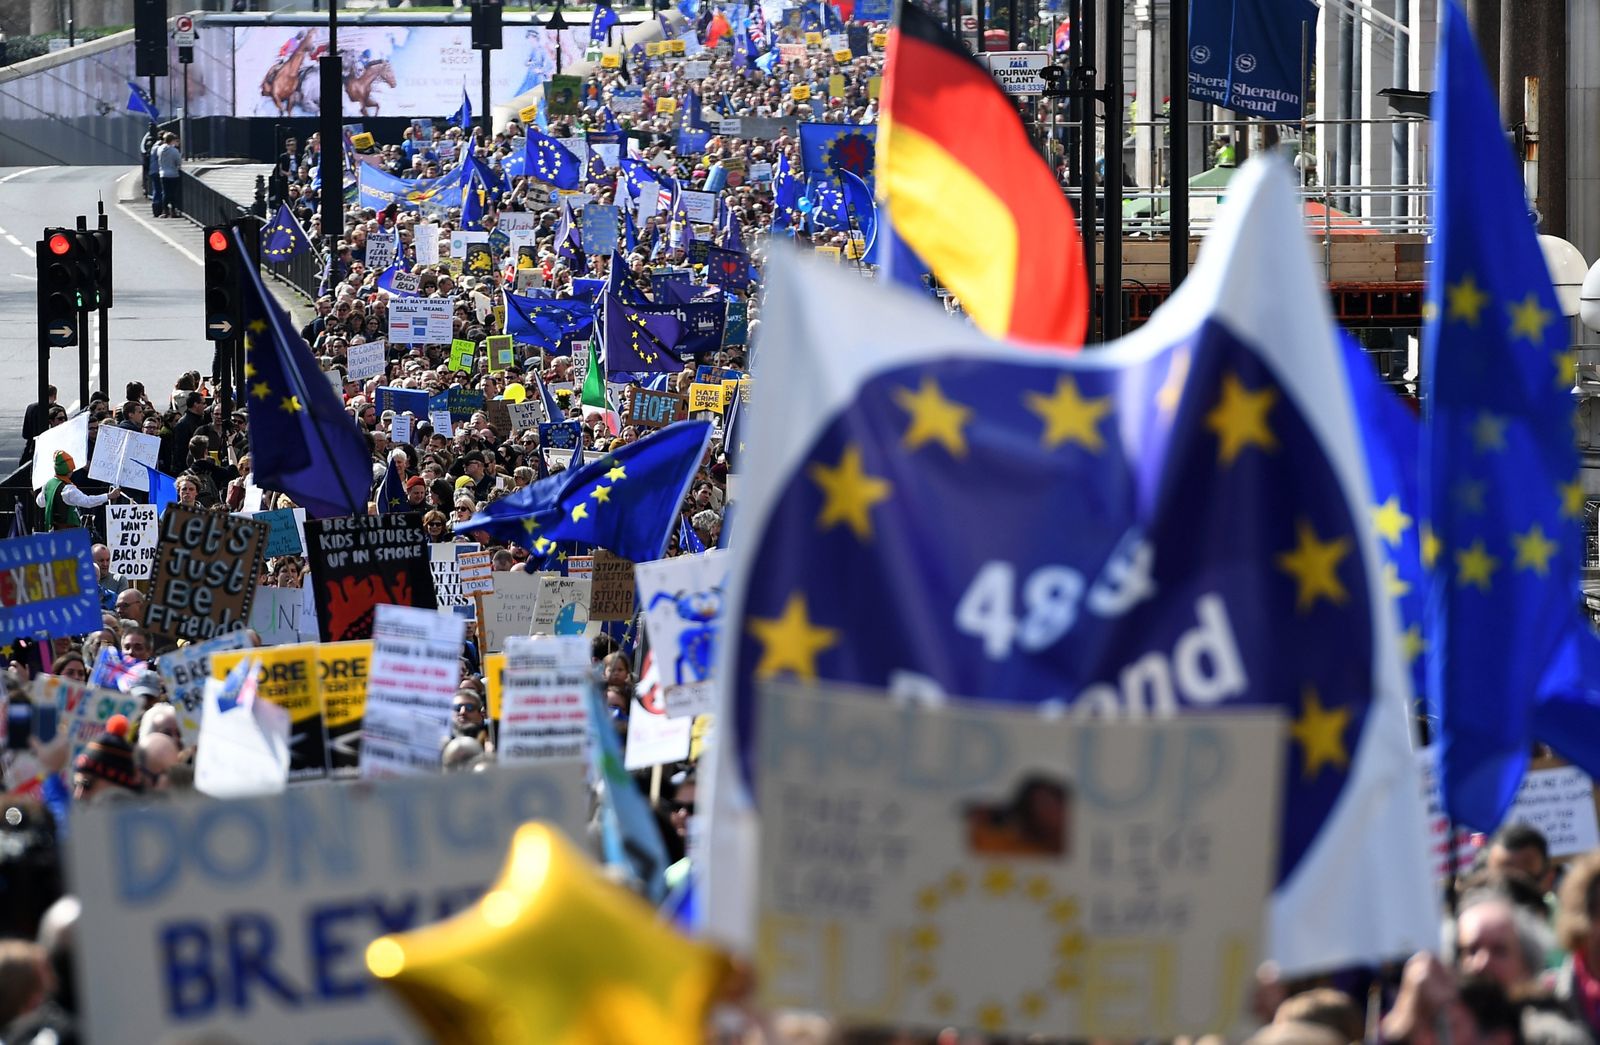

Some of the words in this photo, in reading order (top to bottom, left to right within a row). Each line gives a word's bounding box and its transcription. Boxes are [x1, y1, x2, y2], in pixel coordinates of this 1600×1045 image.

[440, 47, 474, 55] ROYAL
[440, 56, 474, 64] ASCOT
[1188, 72, 1228, 88] Shera
[1231, 82, 1299, 104] Sheraton
[1231, 94, 1277, 113] Grand
[396, 282, 415, 291] BAD
[633, 392, 679, 424] HOPE
[518, 418, 540, 427] LEAVE
[111, 508, 127, 520] WE
[391, 514, 407, 526] IS
[121, 521, 148, 531] WANT
[120, 532, 141, 547] EU
[319, 533, 354, 550] KIDS
[112, 548, 137, 562] BACK
[141, 547, 156, 560] FOR
[326, 551, 348, 568] UP
[352, 549, 370, 564] IN
[375, 544, 422, 560] SMOKE
[461, 556, 487, 565] BREXIT
[117, 563, 148, 575] GOOD
[570, 560, 593, 569] BREXI
[595, 562, 632, 571] STUPID
[466, 580, 489, 589] TOXIC
[437, 595, 469, 606] NESS
[593, 590, 633, 601] STUPID
[591, 601, 632, 613] BREXIT
[496, 612, 512, 622] EU
[173, 656, 210, 685] BRE
[257, 660, 307, 684] ORE
[318, 657, 368, 680] ORE
